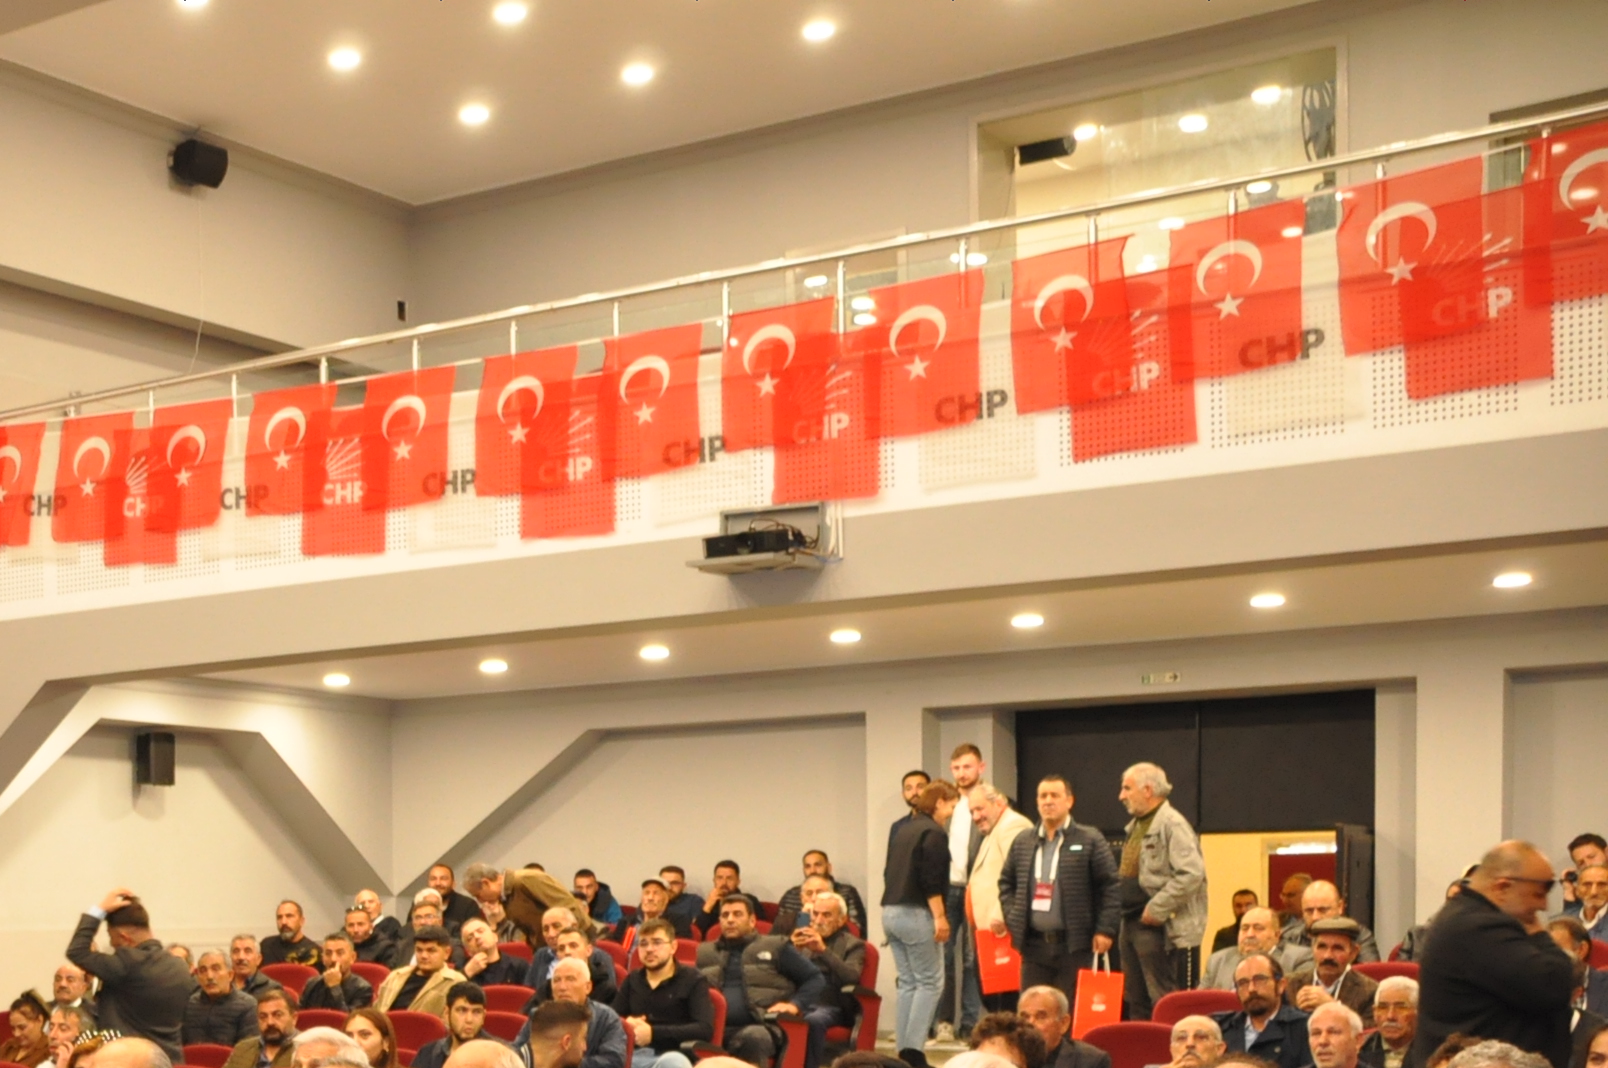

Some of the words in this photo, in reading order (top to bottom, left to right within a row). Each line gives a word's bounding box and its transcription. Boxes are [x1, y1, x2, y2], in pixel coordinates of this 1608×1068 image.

[1239, 327, 1326, 371] CHP
[934, 389, 1008, 424] CHP
[662, 435, 724, 468] CHP
[320, 481, 366, 505] CHP
[422, 468, 476, 497] CHP
[23, 494, 67, 517] CHP
[220, 484, 269, 511] CHP
